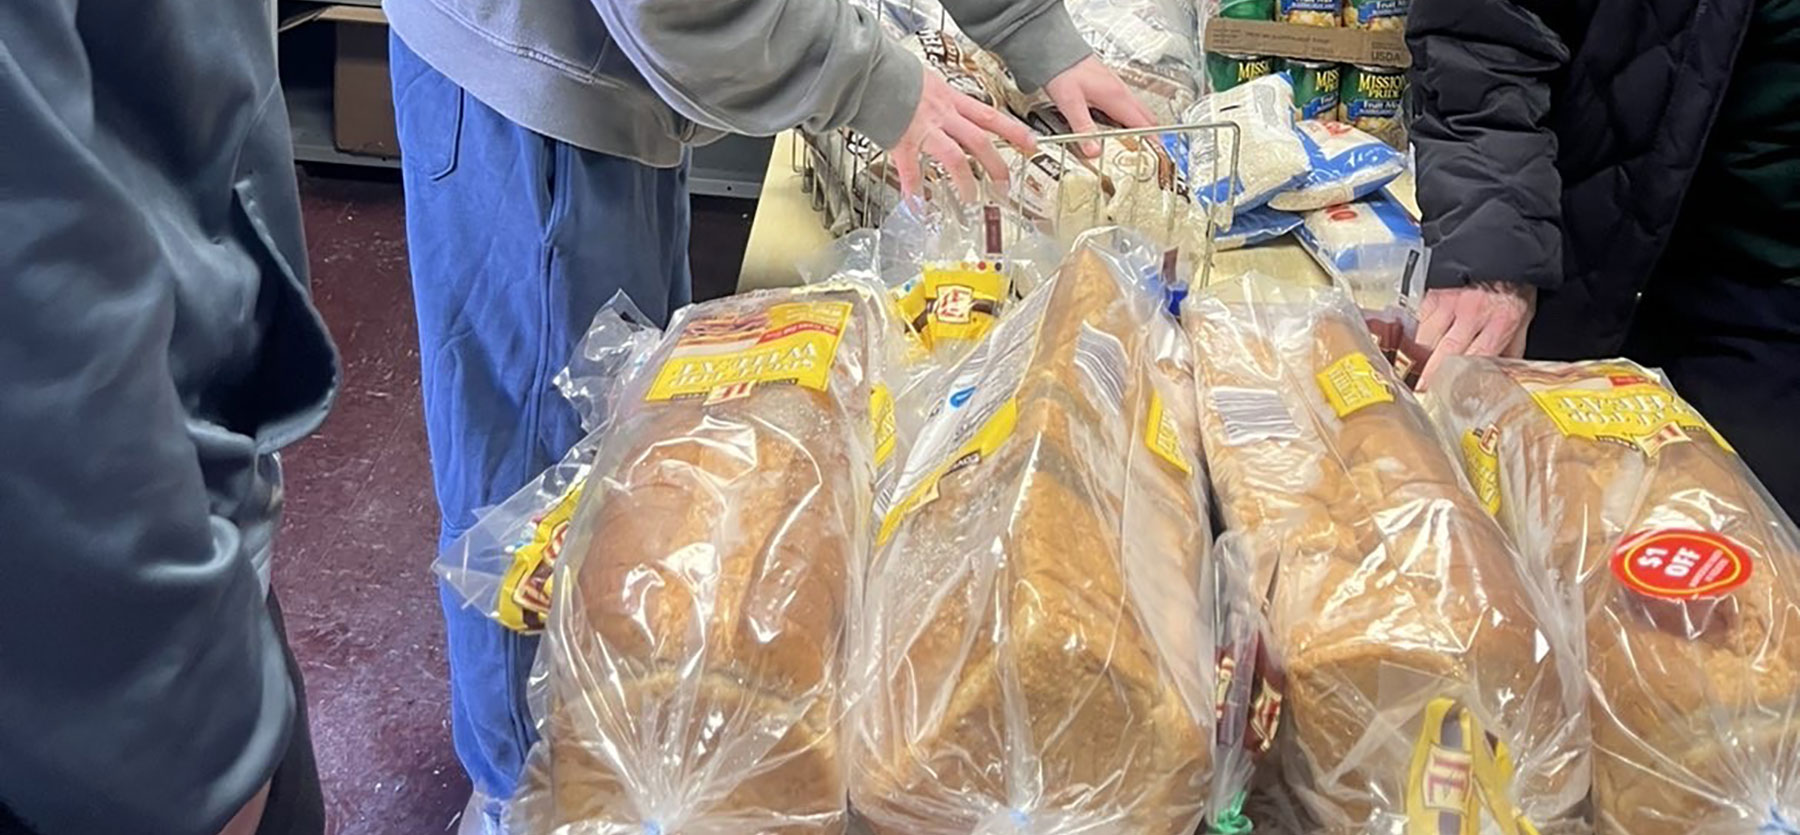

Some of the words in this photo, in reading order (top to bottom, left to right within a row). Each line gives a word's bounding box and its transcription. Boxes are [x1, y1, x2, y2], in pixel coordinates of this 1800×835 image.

[1371, 51, 1400, 62] USDA
[1637, 547, 1669, 568] $1
[1664, 546, 1701, 577] OFF
